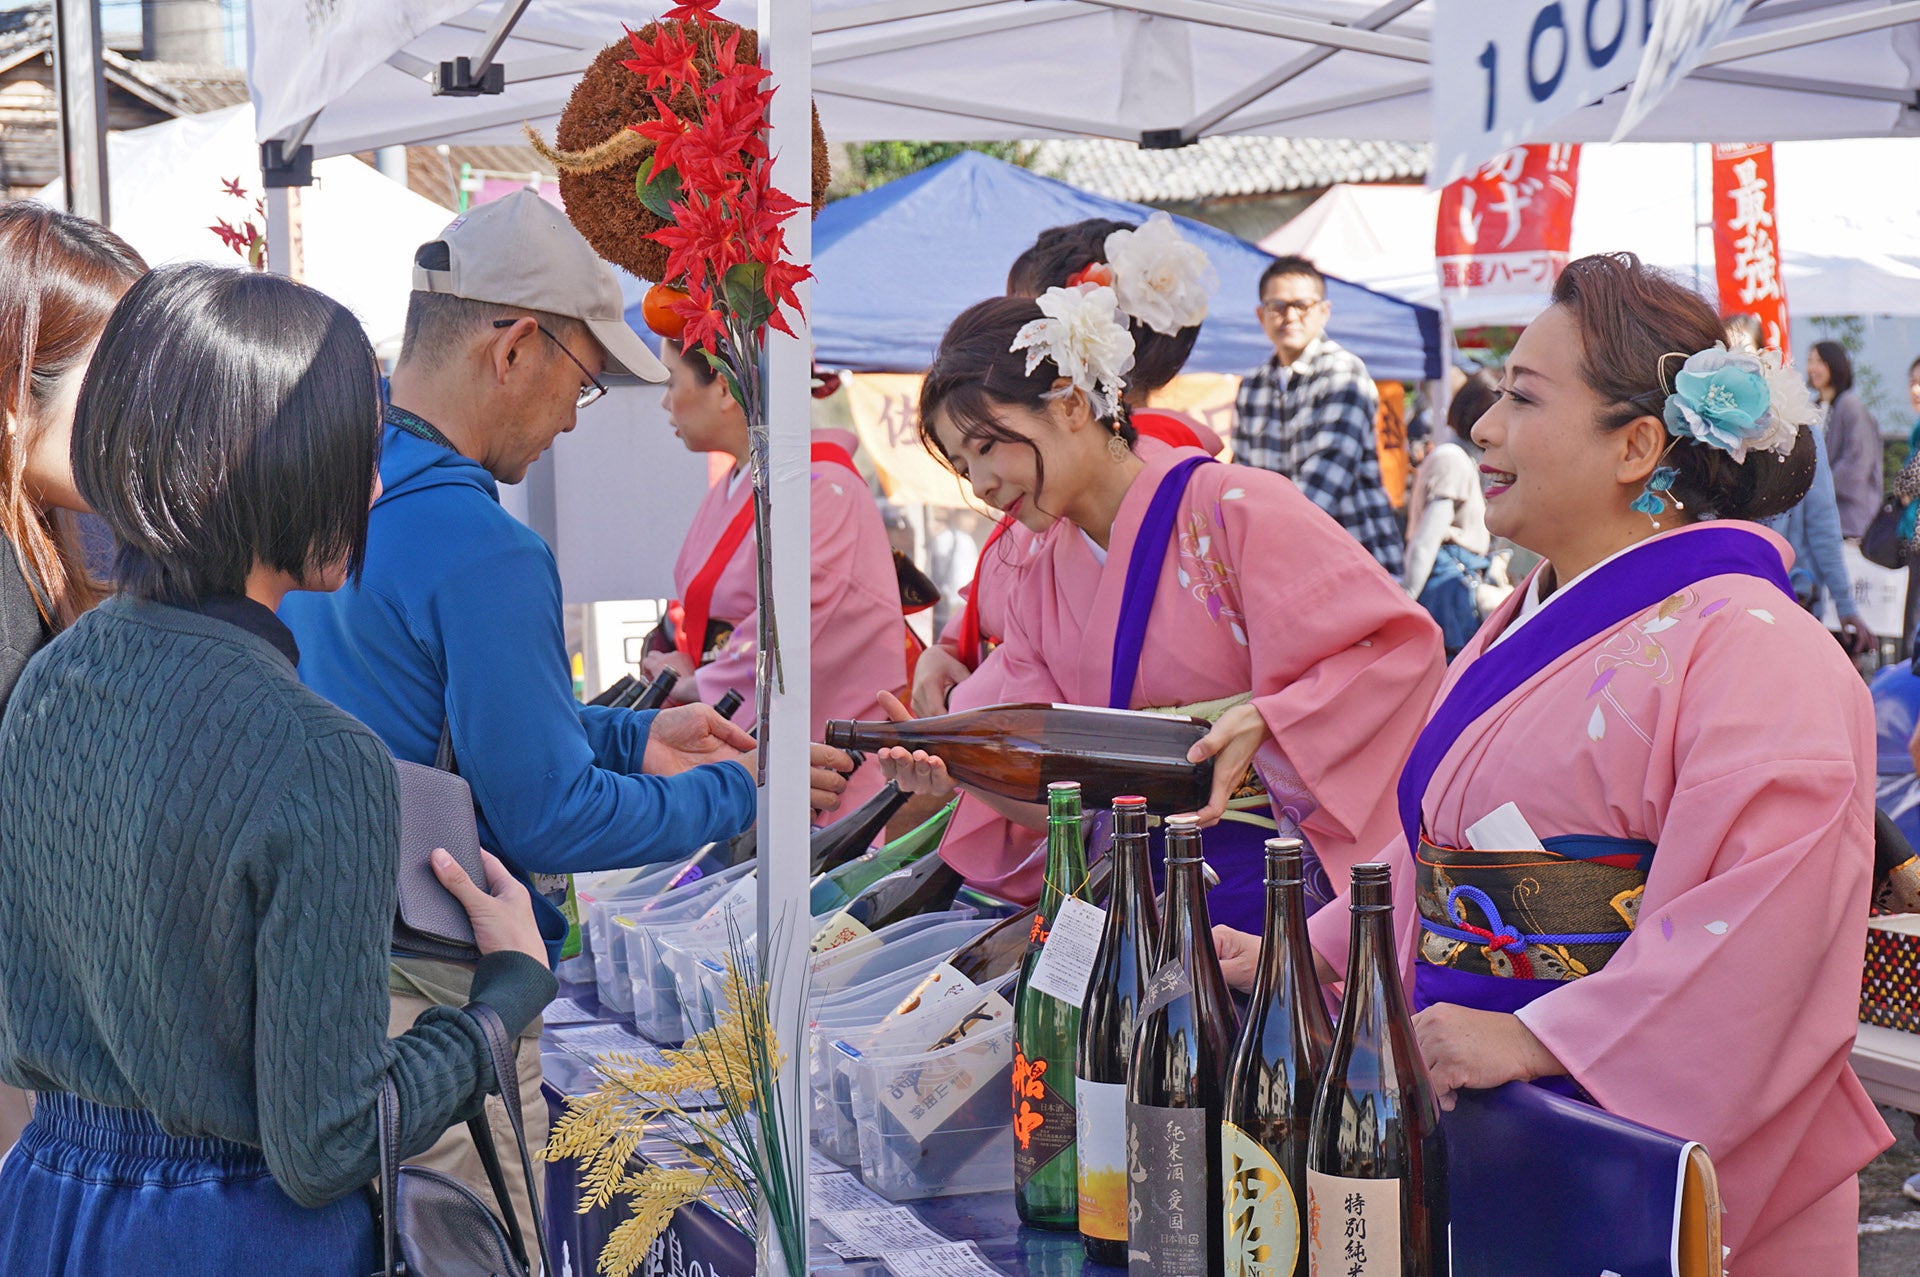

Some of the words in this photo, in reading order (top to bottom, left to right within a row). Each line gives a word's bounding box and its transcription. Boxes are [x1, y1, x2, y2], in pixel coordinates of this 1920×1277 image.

[1478, 0, 1653, 132] 100
[1727, 157, 1783, 346] 最強
[1163, 1119, 1187, 1183] 純米酒
[1167, 1188, 1185, 1231] 愛国
